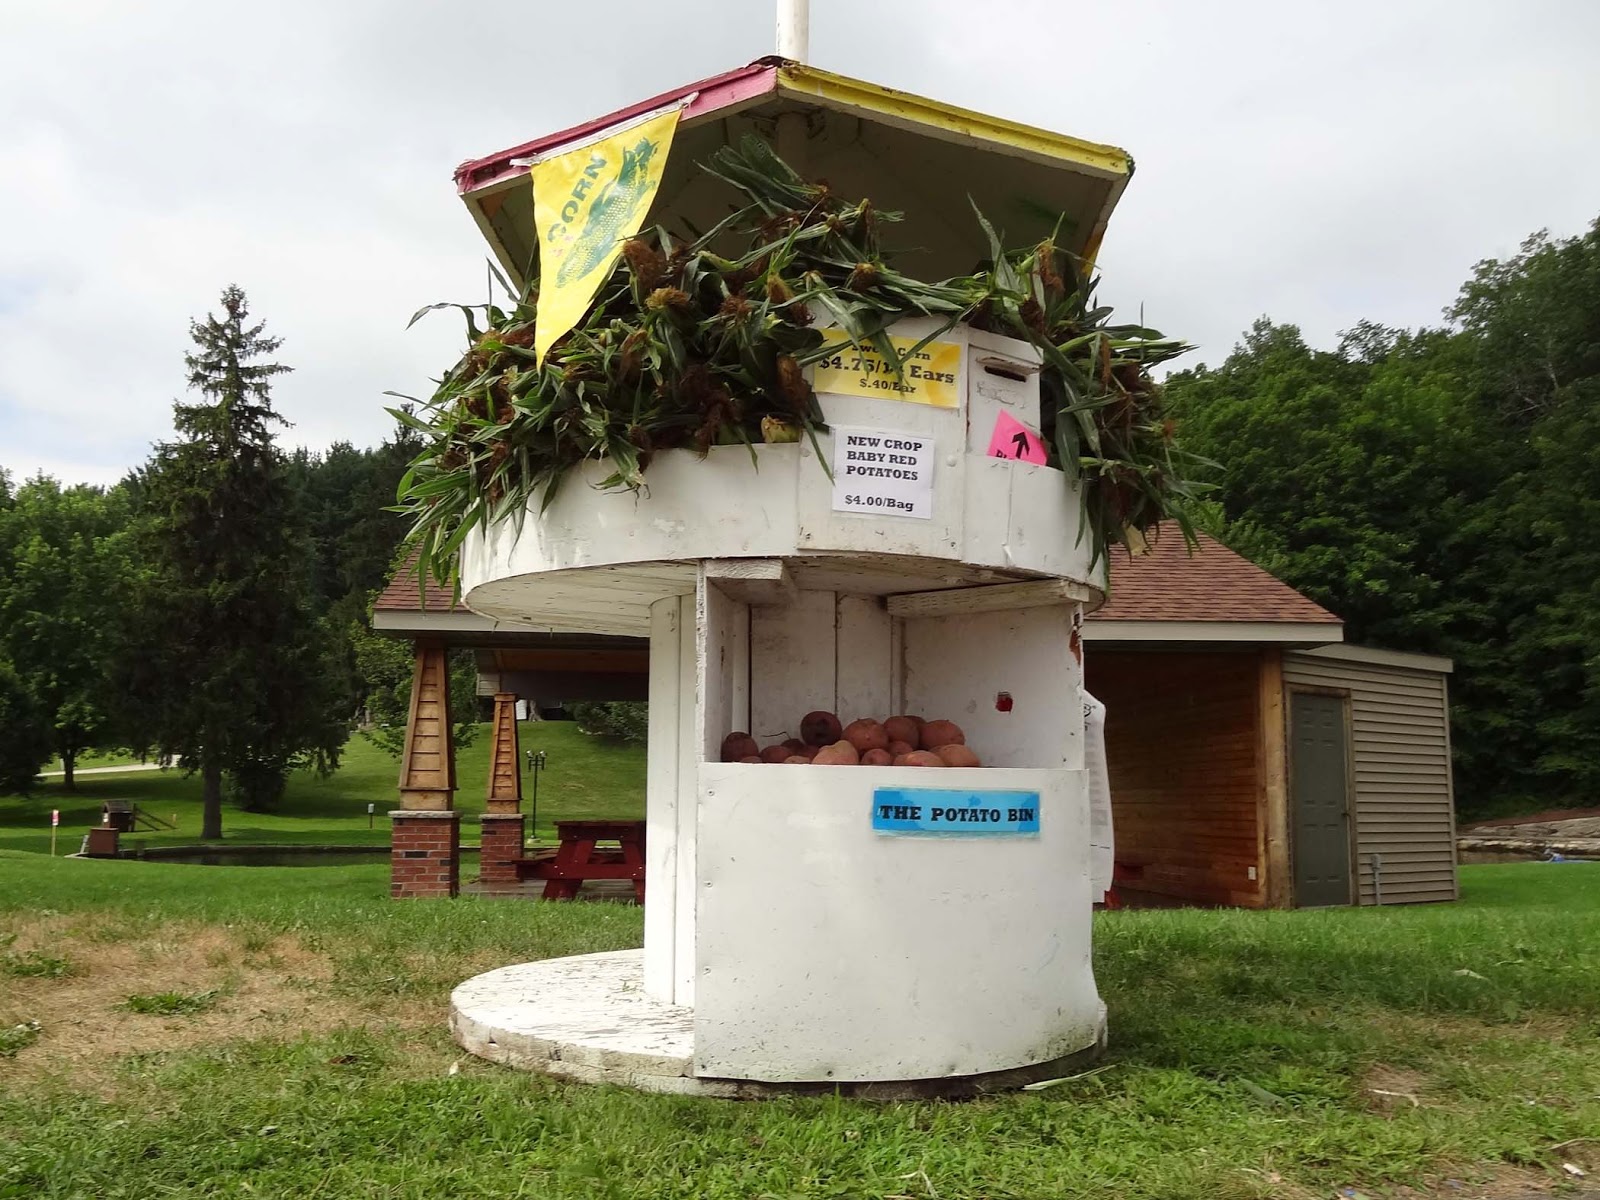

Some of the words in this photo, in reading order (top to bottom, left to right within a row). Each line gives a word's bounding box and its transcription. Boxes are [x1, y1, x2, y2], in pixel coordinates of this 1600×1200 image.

[547, 153, 607, 242] CORN
[897, 347, 931, 360] Crn
[819, 355, 903, 375] $4.75/1
[910, 365, 955, 384] Ears
[847, 435, 880, 447] NEW
[884, 439, 922, 451] CROP
[846, 450, 885, 462] BABY
[888, 453, 917, 466] RED
[846, 465, 918, 481] POTATOES
[844, 494, 914, 512] $4.00/Bag
[880, 805, 922, 820] THE
[931, 807, 1001, 822] POTATO
[1007, 808, 1034, 821] BIN
